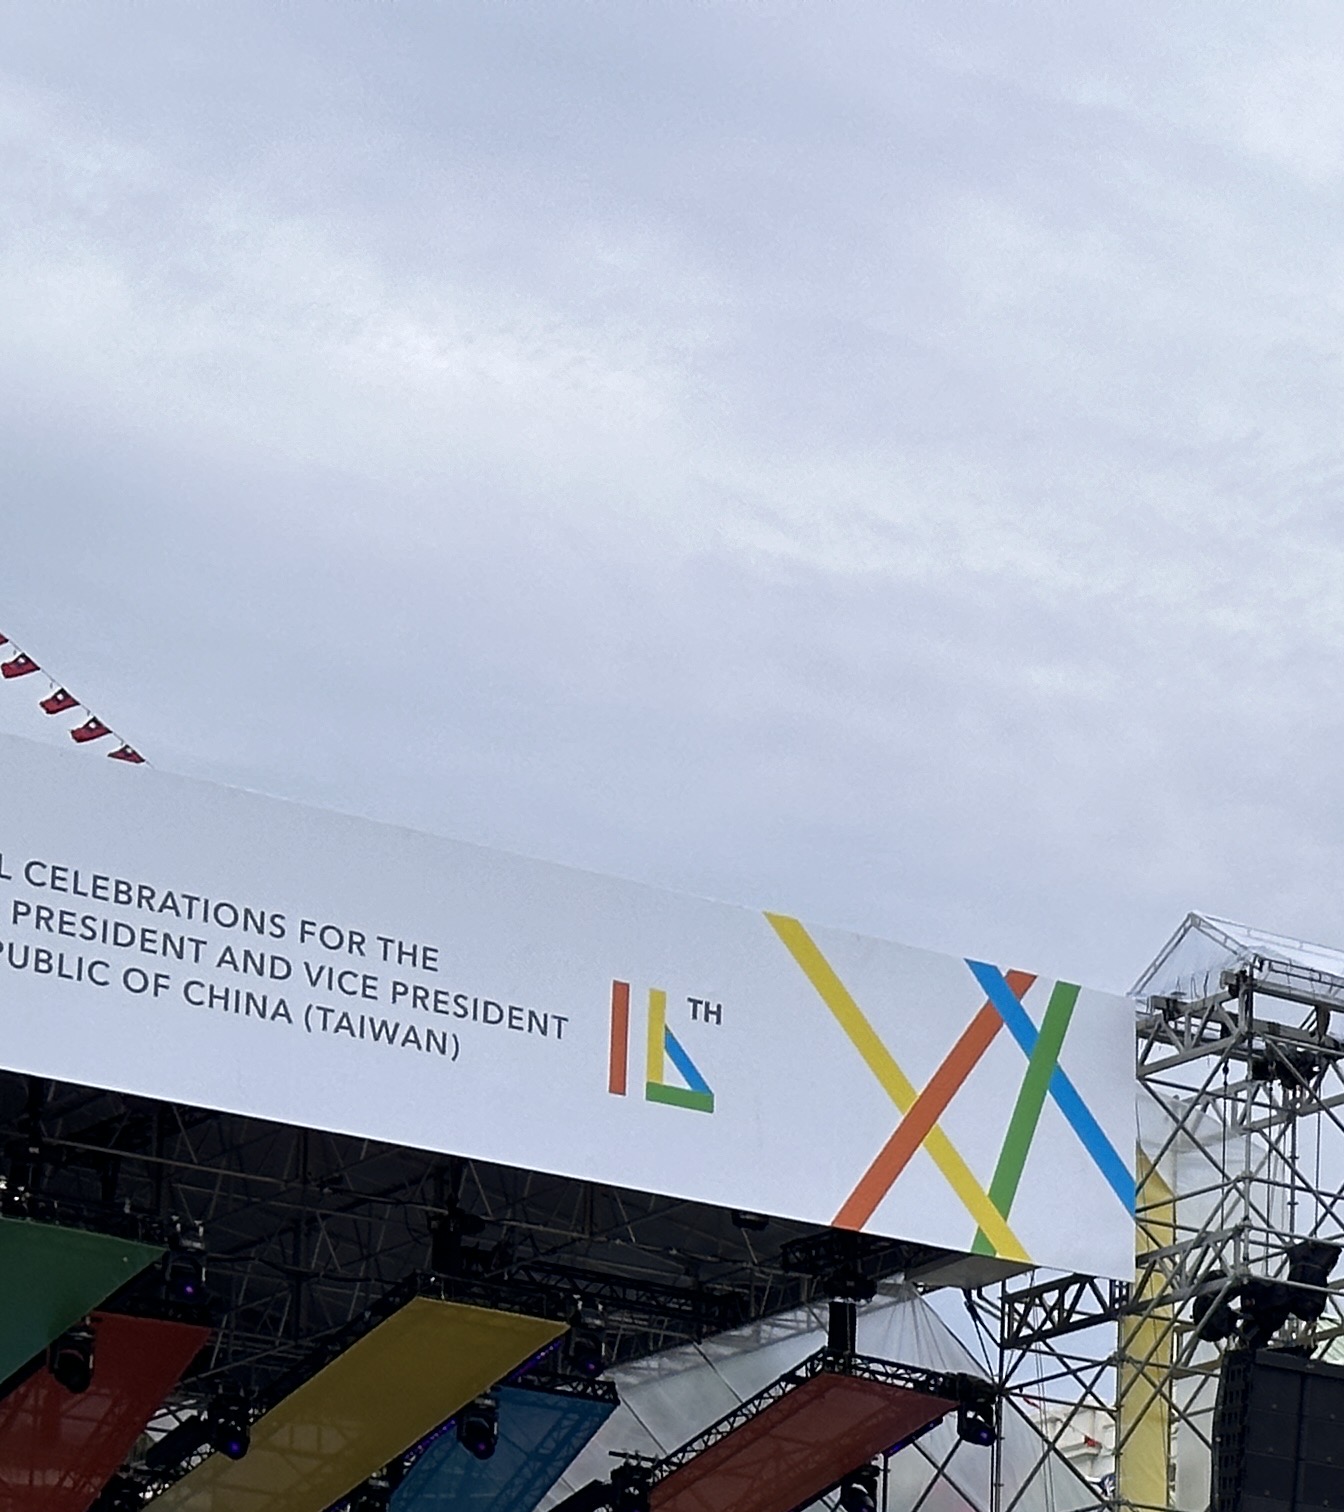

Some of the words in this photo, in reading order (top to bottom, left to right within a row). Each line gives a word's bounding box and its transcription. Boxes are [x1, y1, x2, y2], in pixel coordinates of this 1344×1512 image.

[12, 899, 208, 963] PRESIDENT
[216, 945, 292, 981] AND
[303, 961, 378, 1000] VICE
[391, 980, 569, 1040] PRESIDENT
[24, 860, 286, 939] CELEBRATIONS
[300, 919, 366, 957] FOR
[377, 937, 439, 972] THE
[0, 941, 110, 987] UBLIC
[122, 967, 170, 998] OF
[183, 980, 292, 1025] CHINA
[304, 1003, 461, 1062] (TAIWAN)
[687, 997, 723, 1026] TH
